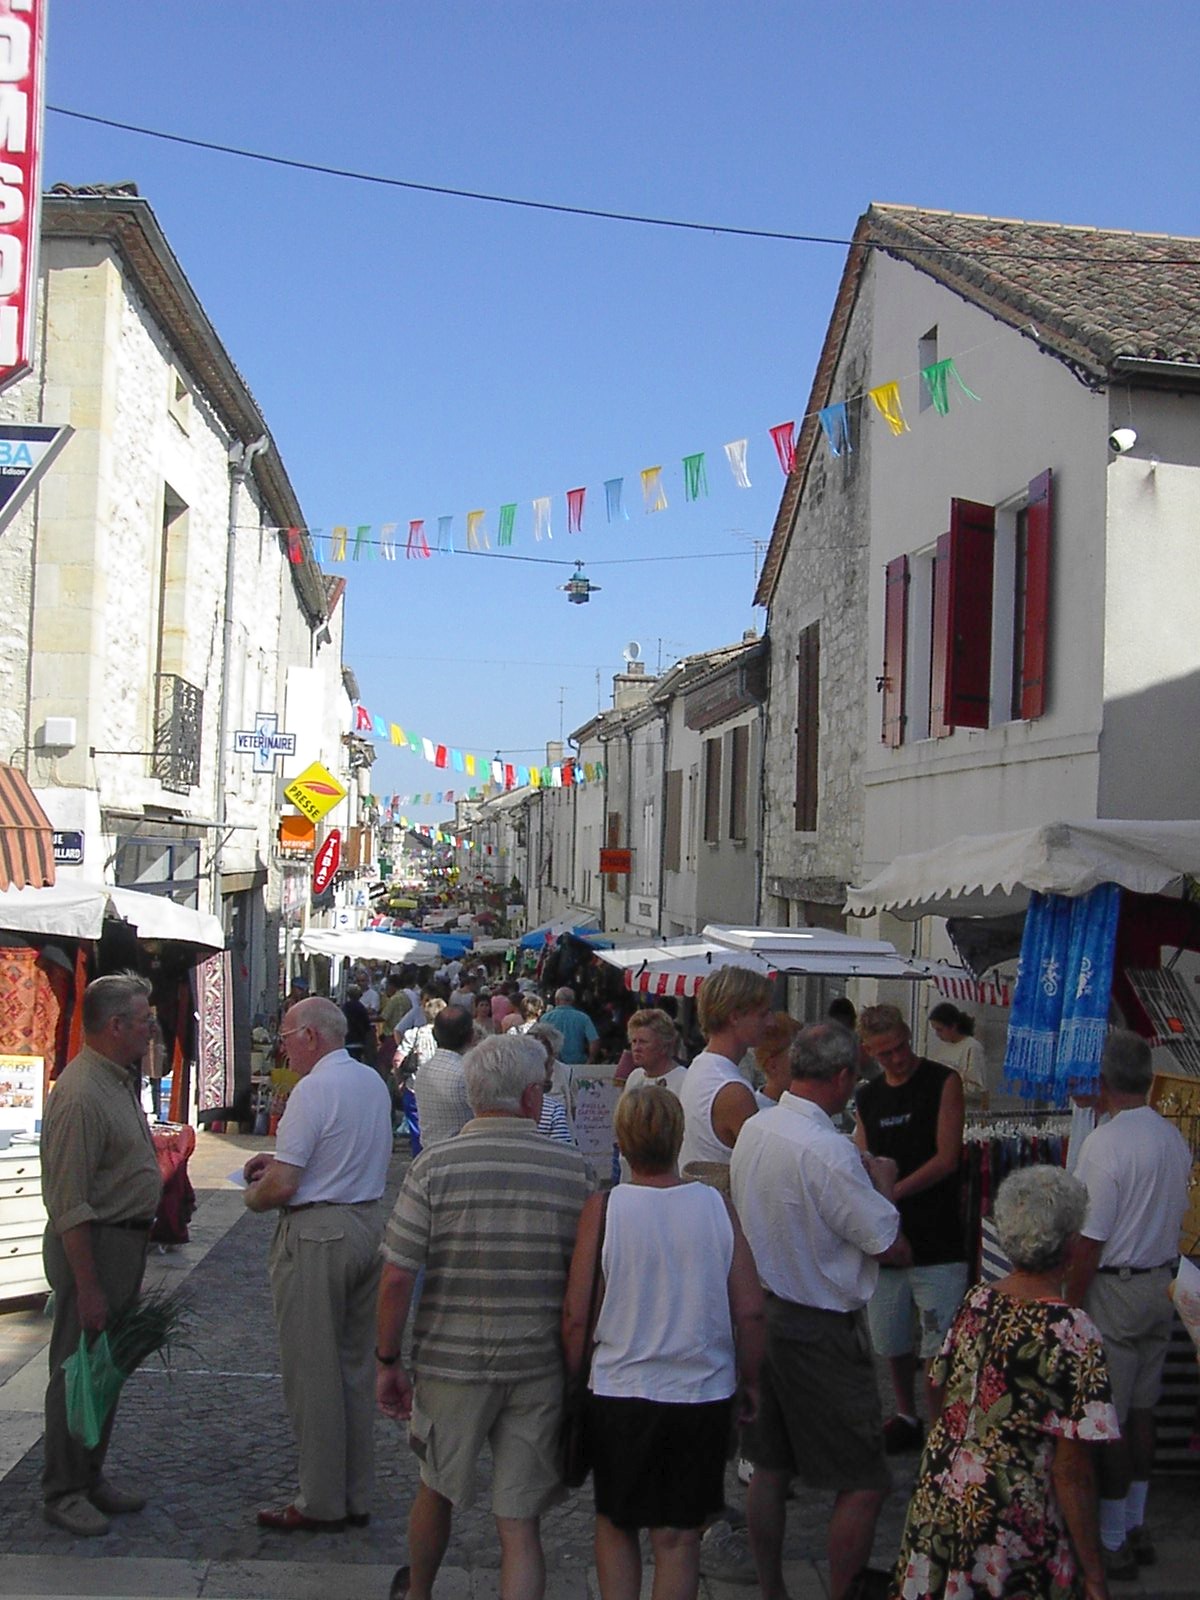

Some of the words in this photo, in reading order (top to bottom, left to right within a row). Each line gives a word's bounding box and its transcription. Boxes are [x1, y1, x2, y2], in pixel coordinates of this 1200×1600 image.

[289, 784, 320, 819] PRESSE
[282, 840, 311, 849] orange
[316, 838, 338, 885] TABAC
